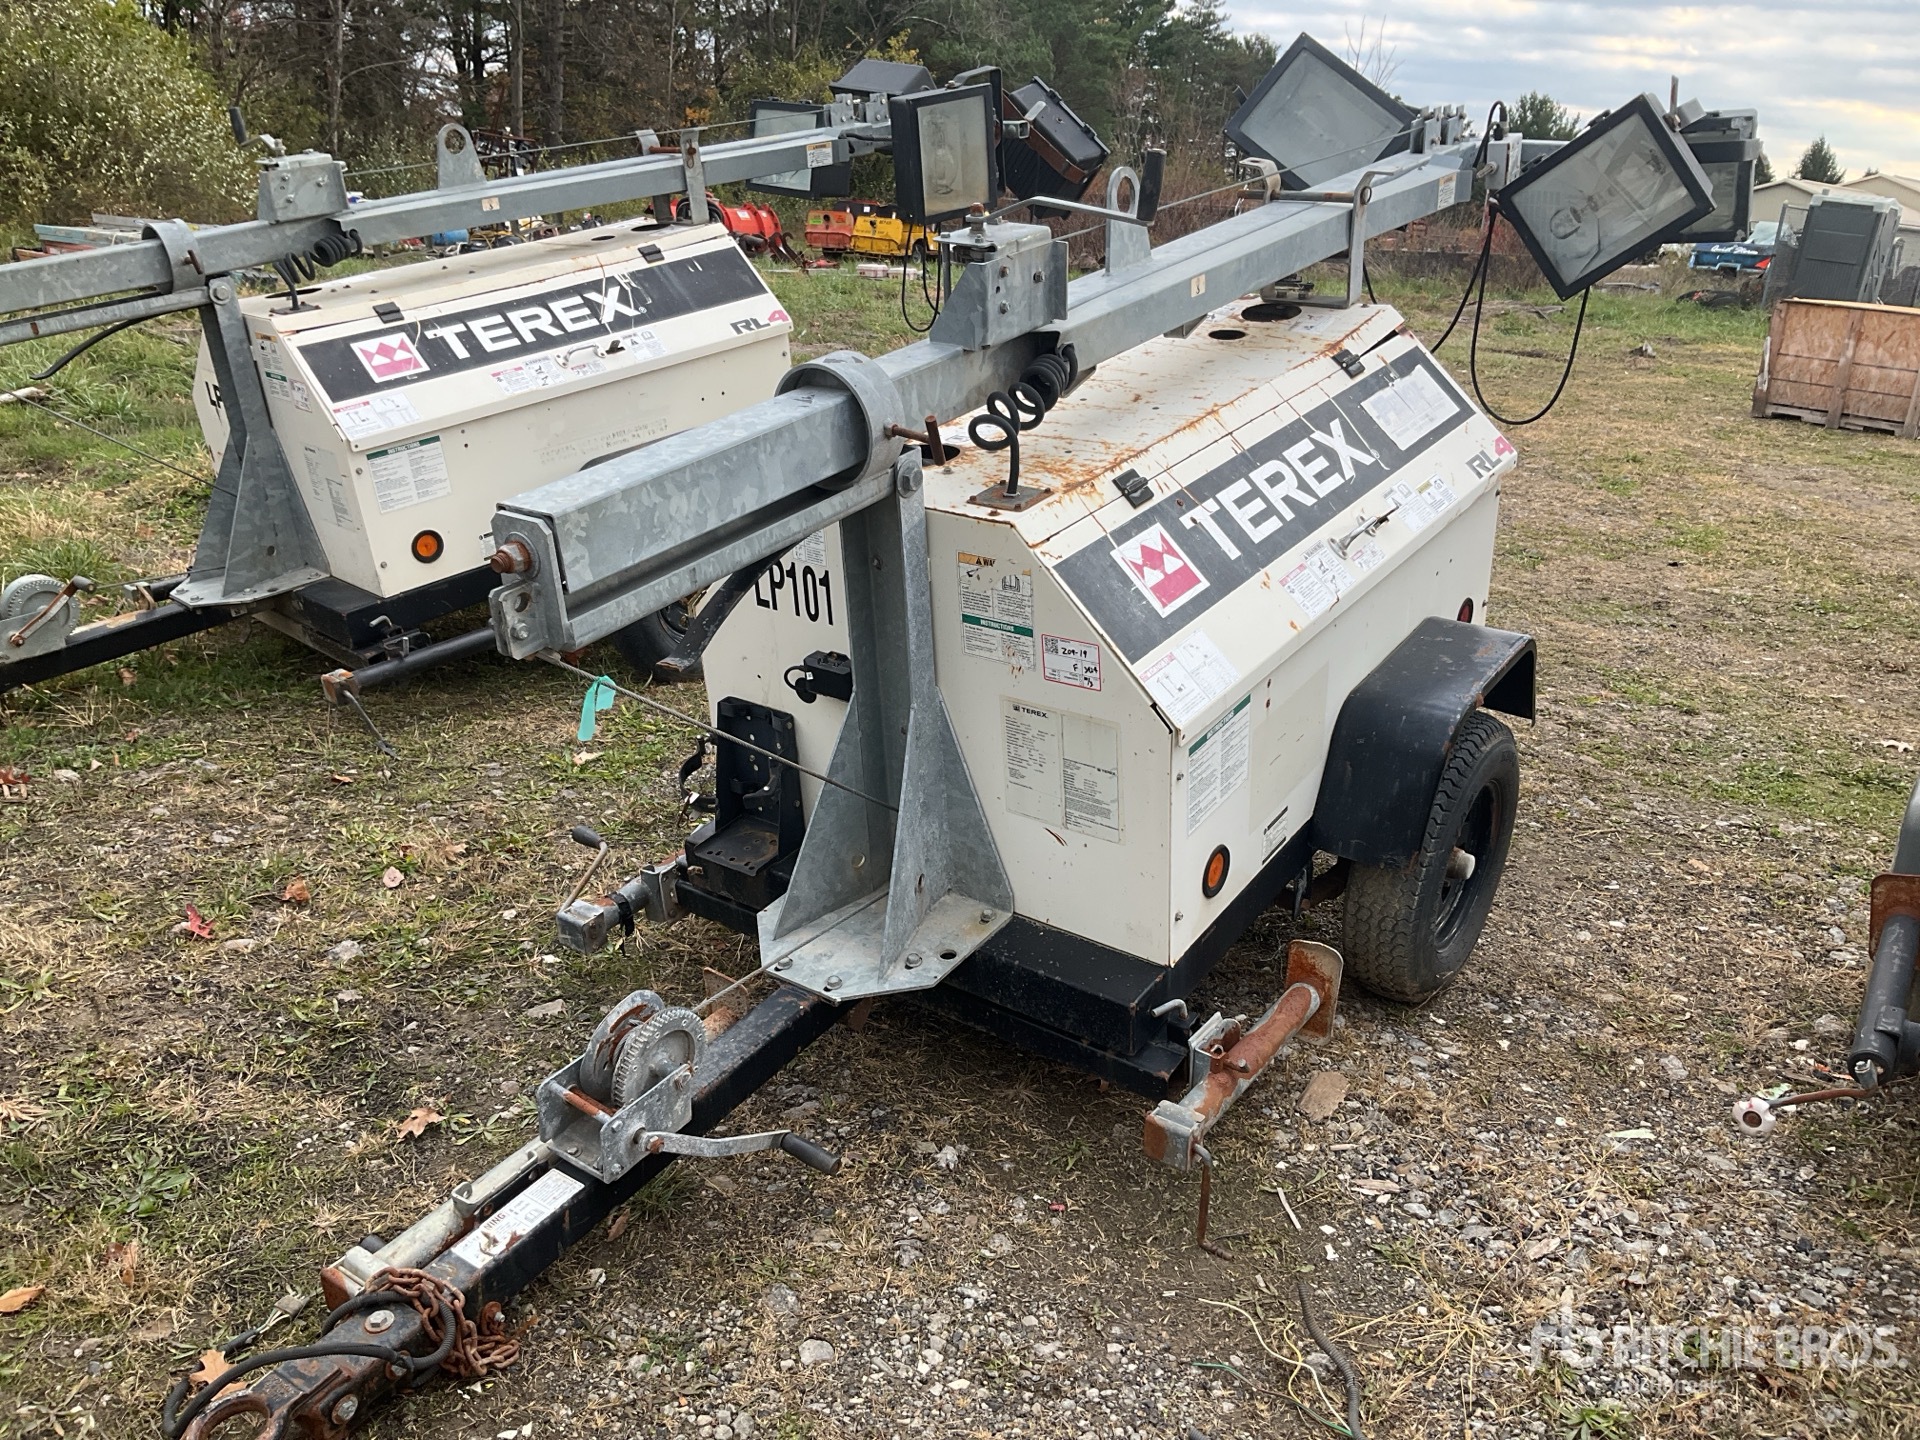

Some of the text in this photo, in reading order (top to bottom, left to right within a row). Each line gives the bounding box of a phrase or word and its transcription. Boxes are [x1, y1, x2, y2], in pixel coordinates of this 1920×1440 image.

[424, 286, 642, 360] TEREX
[729, 309, 790, 335] RL4
[1465, 435, 1515, 480] RL4
[1178, 417, 1377, 561] TEREX
[754, 559, 834, 626] LP101
[980, 619, 1014, 632] INSTRUCTIONS
[1021, 706, 1047, 718] TEREX
